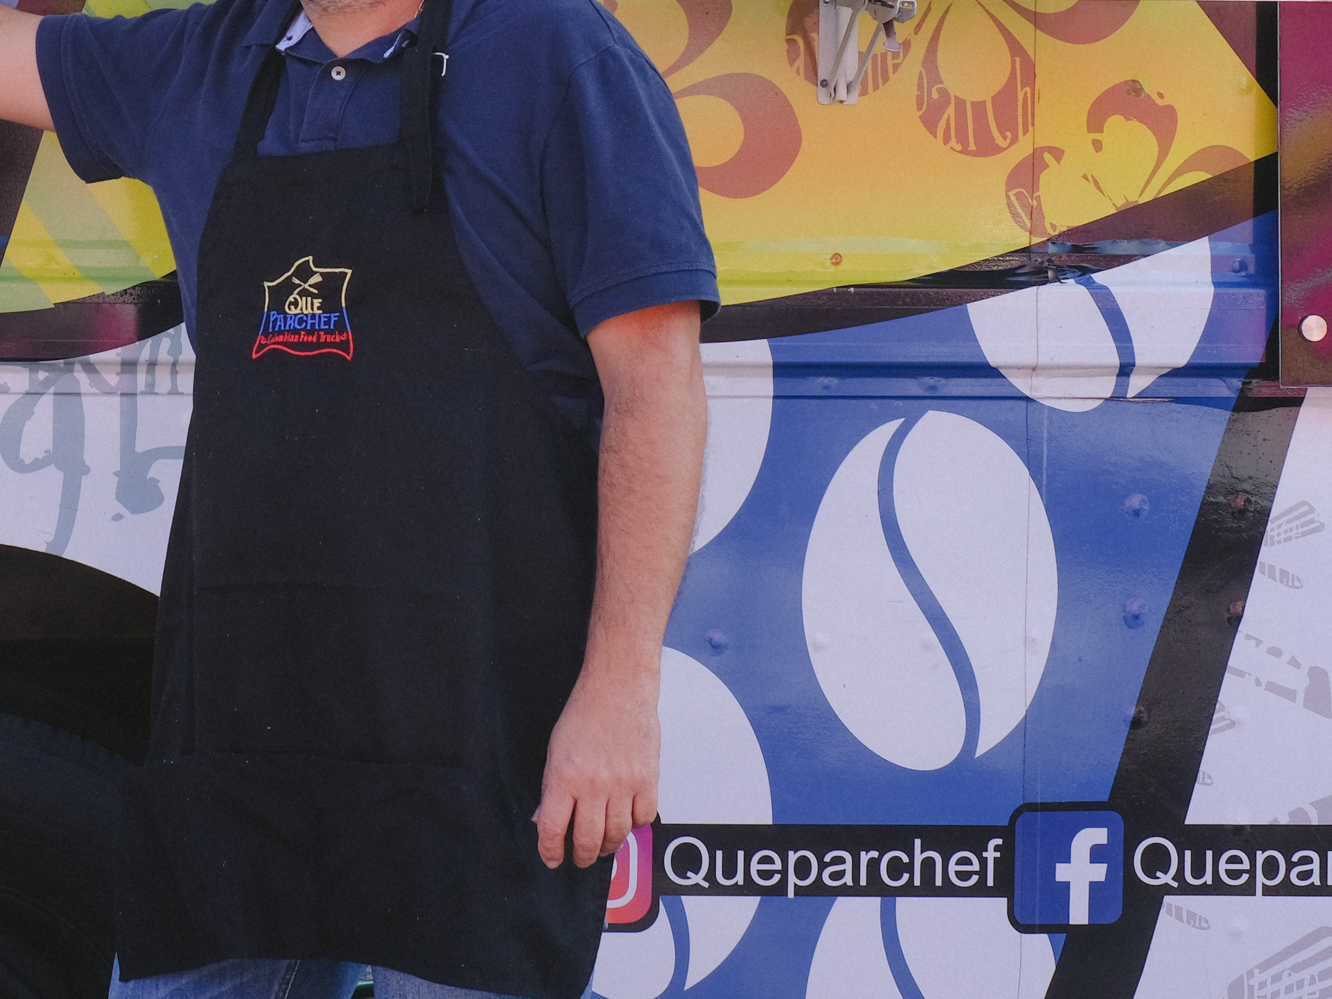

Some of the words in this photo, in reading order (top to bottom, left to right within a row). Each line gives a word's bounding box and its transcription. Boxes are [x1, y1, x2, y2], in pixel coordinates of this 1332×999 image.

[269, 311, 340, 332] PARCHEF
[319, 331, 341, 343] Truck
[663, 837, 1002, 898] Queparchef
